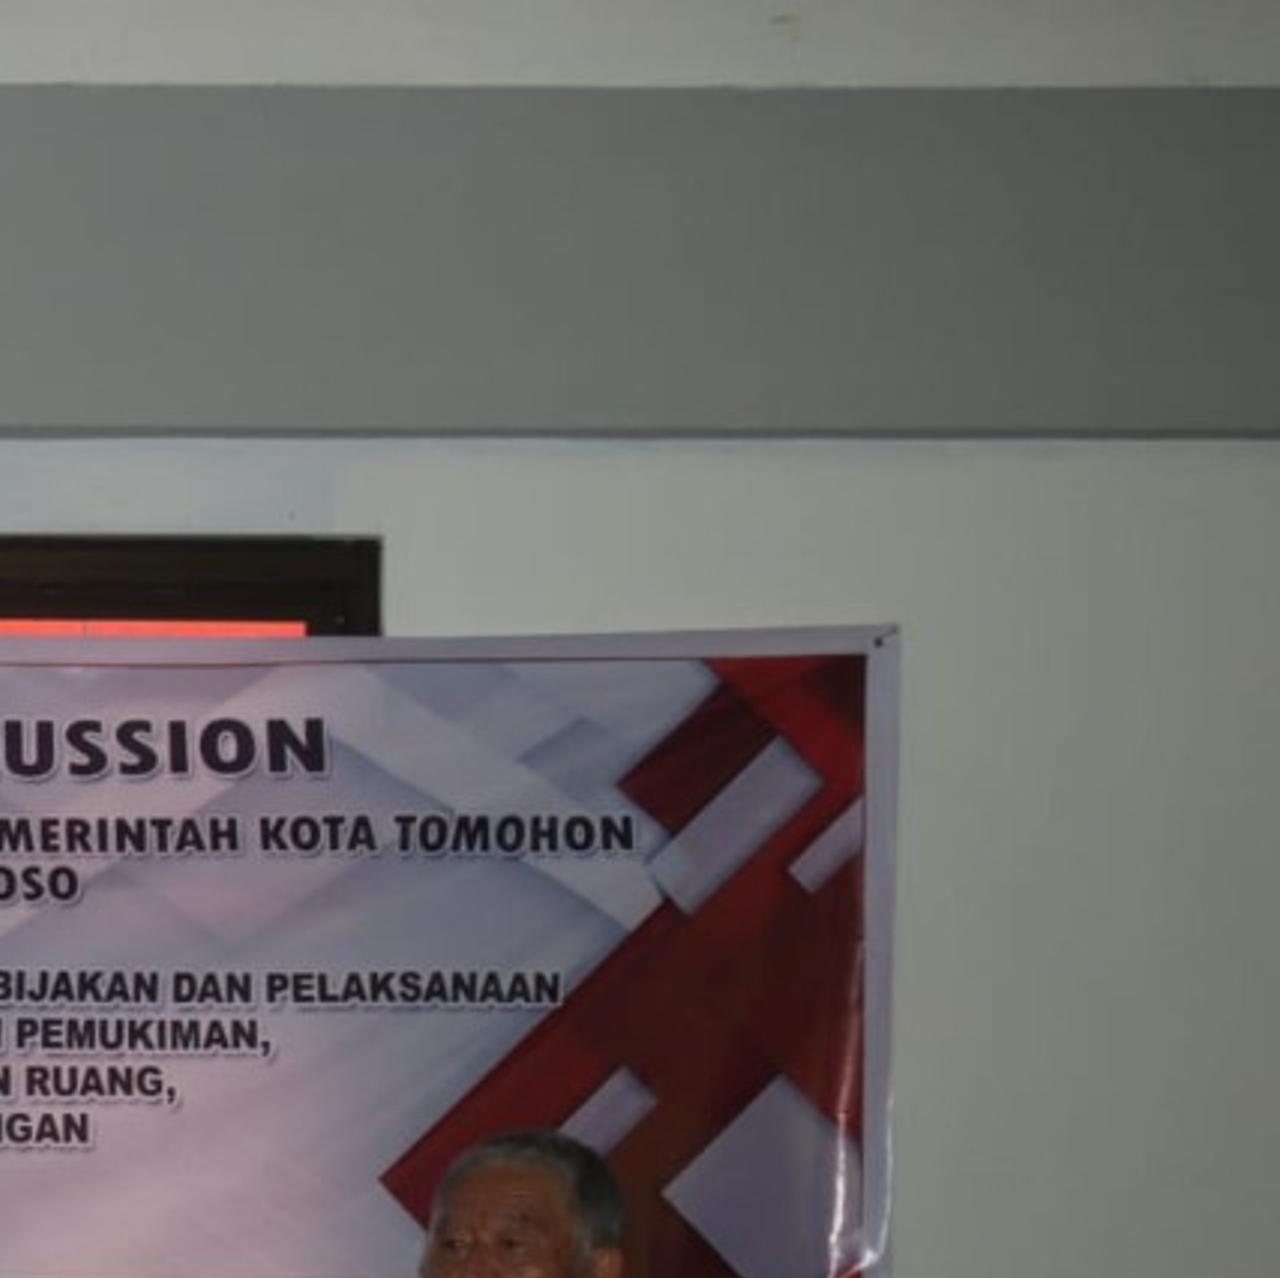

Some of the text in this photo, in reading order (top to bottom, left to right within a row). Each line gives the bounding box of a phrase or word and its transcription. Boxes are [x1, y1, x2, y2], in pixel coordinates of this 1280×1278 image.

[260, 816, 377, 852] KOTA
[396, 815, 635, 852] TOMOHON
[173, 971, 251, 1004] DAN
[266, 971, 562, 1004] PELAKSANAAN
[16, 1018, 272, 1056] PEMUKIMAN,
[26, 1067, 178, 1104] RUANG,
